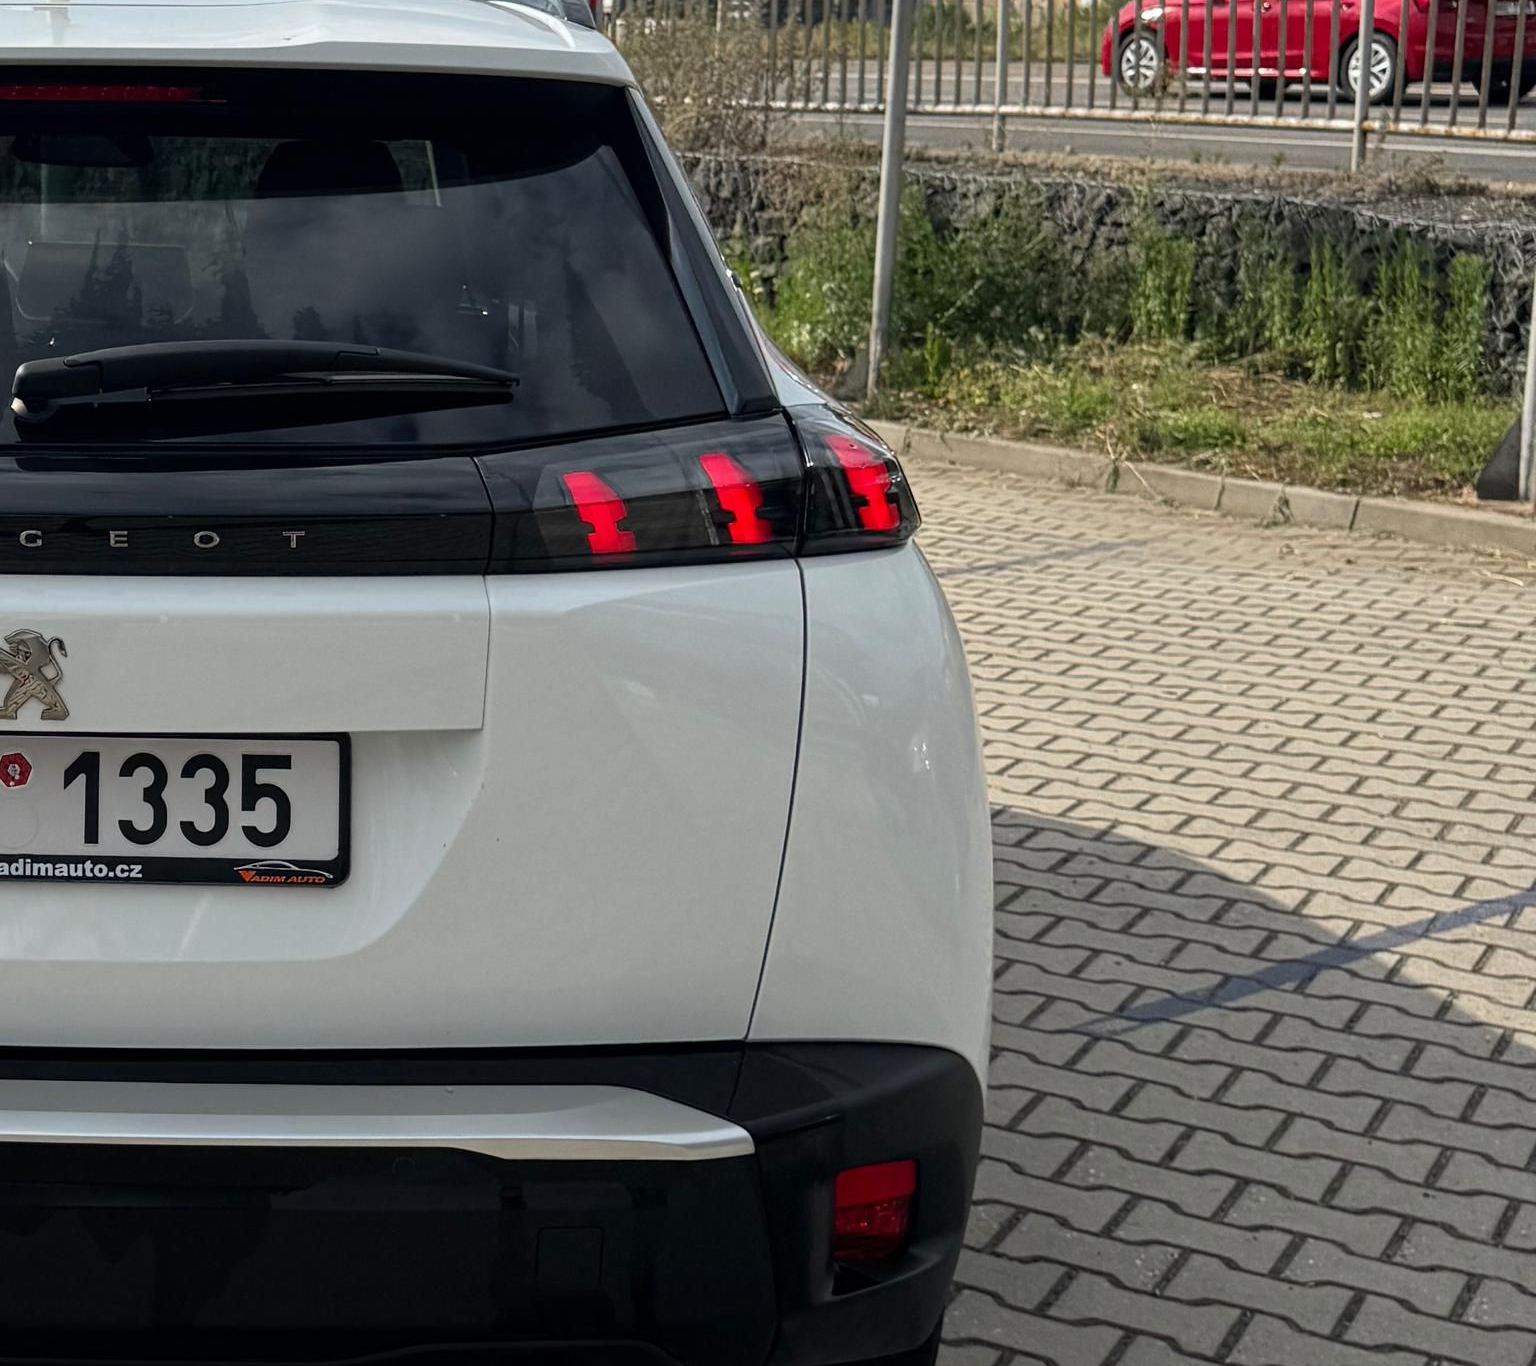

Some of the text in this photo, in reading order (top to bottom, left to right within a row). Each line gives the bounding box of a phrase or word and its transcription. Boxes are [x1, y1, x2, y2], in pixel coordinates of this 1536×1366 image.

[64, 751, 293, 848] 1335
[239, 871, 326, 884] VADIM AUTO
